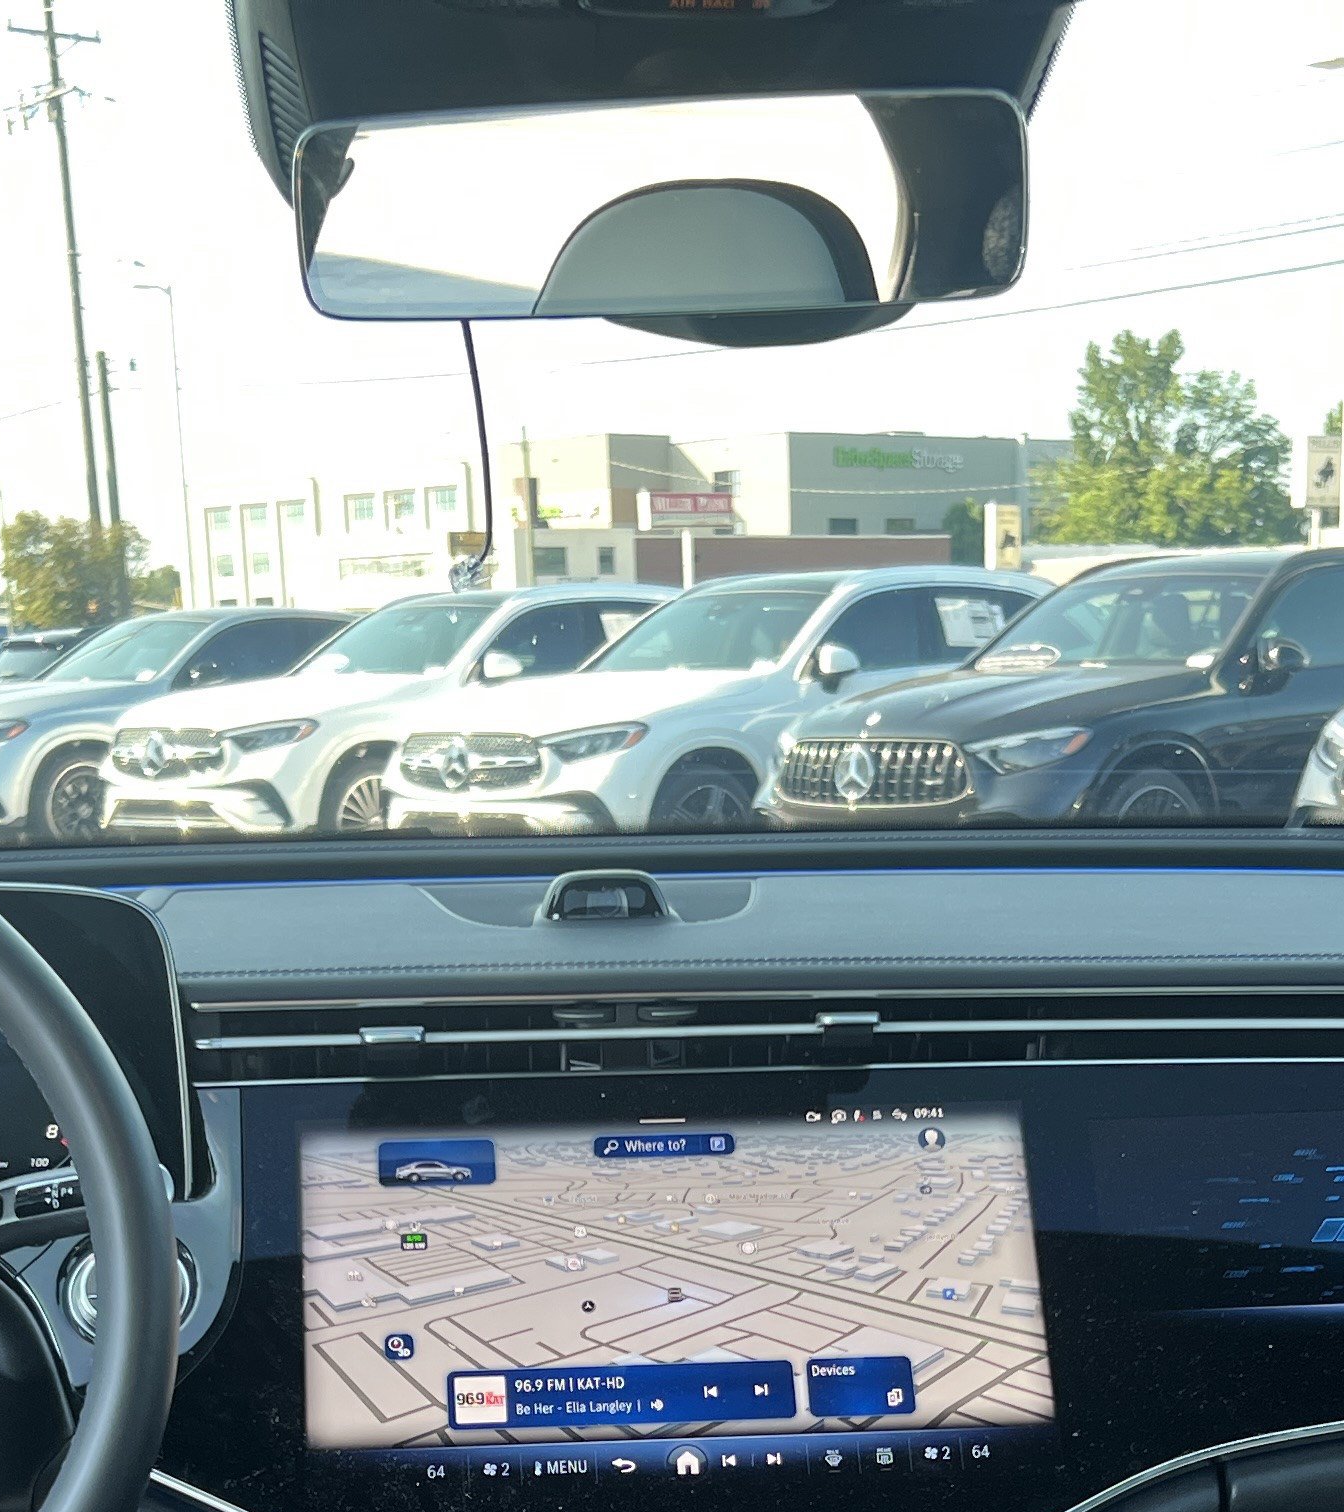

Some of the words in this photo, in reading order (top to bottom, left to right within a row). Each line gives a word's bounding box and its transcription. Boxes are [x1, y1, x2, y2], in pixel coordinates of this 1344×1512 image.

[913, 1107, 944, 1119] 09:41
[45, 1124, 60, 1140] 8
[624, 1139, 664, 1153] Where
[667, 1138, 687, 1151] to?
[30, 1157, 50, 1168] 100
[811, 1365, 855, 1377] Devices
[515, 1379, 543, 1393] 96.9
[547, 1378, 566, 1392] FM
[576, 1376, 625, 1391] KAT-HD
[516, 1402, 531, 1416] Be
[534, 1402, 555, 1414] Her
[565, 1401, 587, 1414] Ella
[589, 1400, 633, 1416] Langley
[941, 1445, 951, 1460] 2
[971, 1444, 991, 1459] 64
[426, 1464, 446, 1479] 64
[501, 1462, 510, 1476] 2
[546, 1459, 588, 1475] MENU
